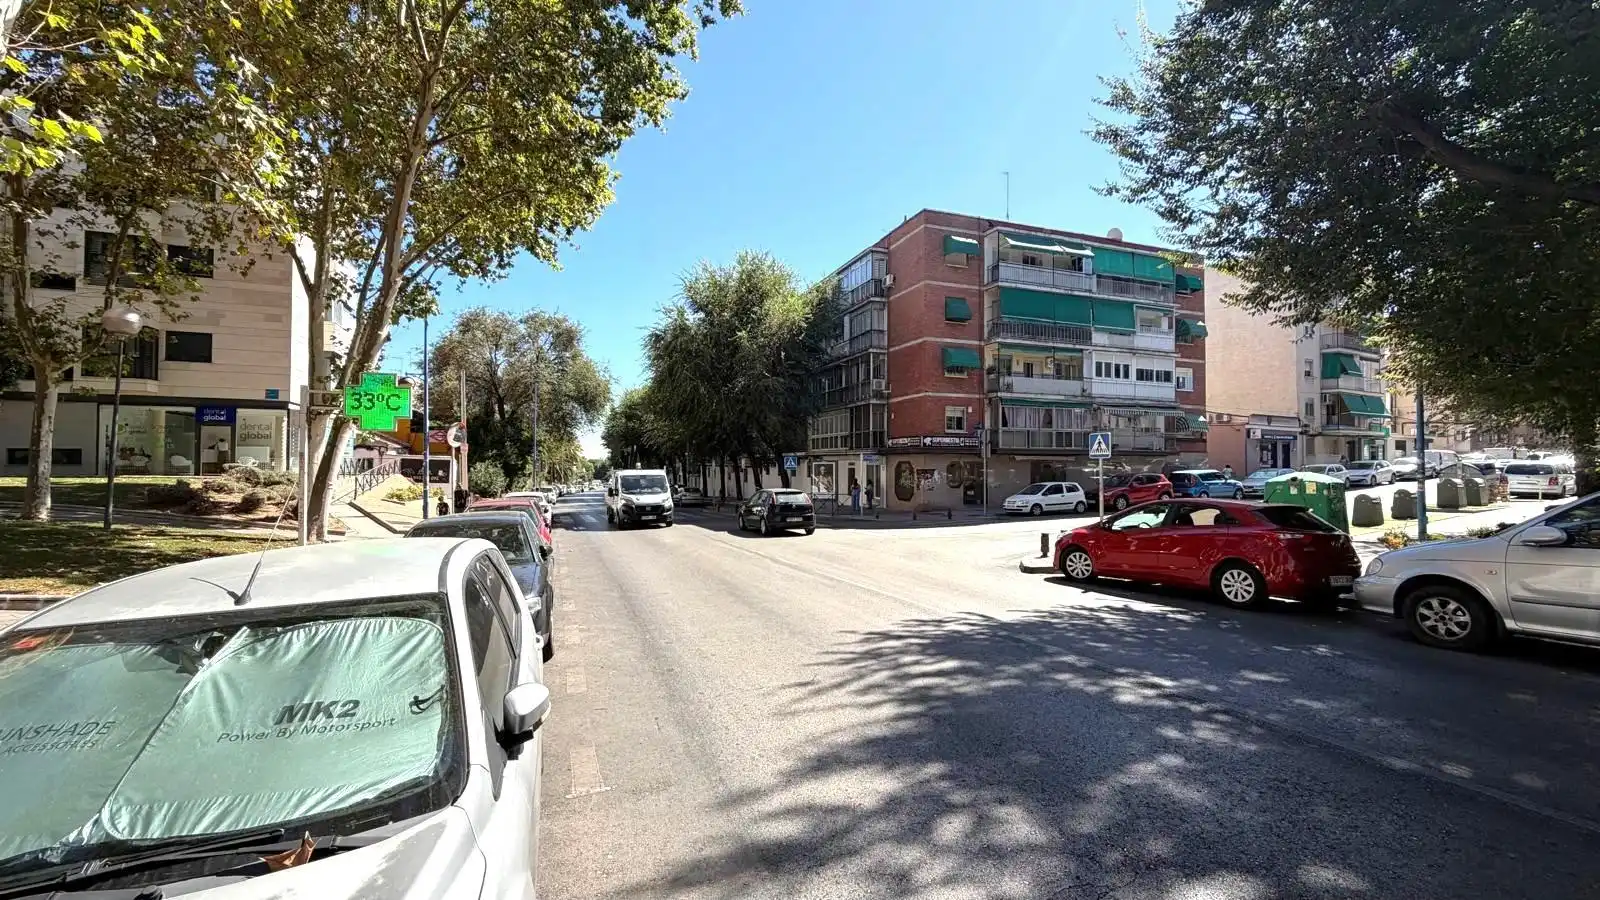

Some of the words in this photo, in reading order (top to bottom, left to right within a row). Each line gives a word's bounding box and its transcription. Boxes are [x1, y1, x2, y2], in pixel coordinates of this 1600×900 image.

[239, 420, 273, 431] dental
[239, 431, 273, 441] global
[273, 699, 361, 726] MK2
[216, 730, 271, 743] Power
[275, 727, 296, 740] By
[300, 716, 397, 736] Motorsport
[1, 740, 97, 756] ACCESSORIES
